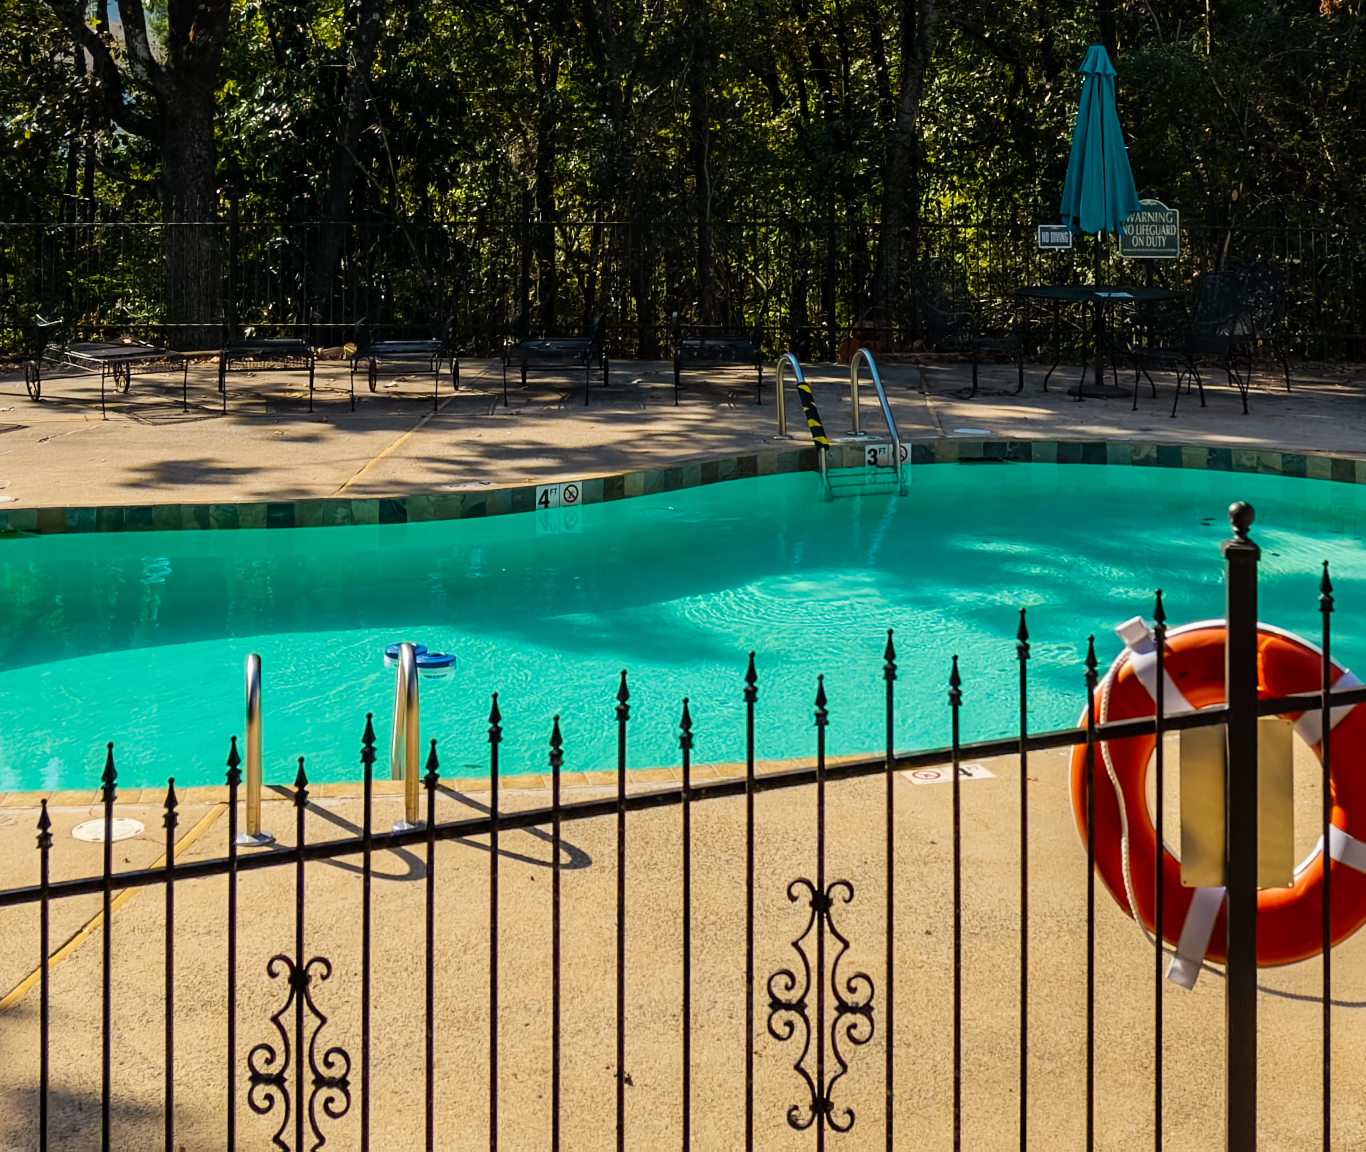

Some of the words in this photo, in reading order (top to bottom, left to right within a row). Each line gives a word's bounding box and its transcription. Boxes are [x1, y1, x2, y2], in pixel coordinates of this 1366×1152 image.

[1135, 224, 1176, 236] LIFEGUARD
[1132, 236, 1144, 247] ON
[1145, 235, 1167, 247] DUTY
[867, 448, 878, 465] 3
[538, 488, 550, 508] 4
[550, 488, 558, 496] FT
